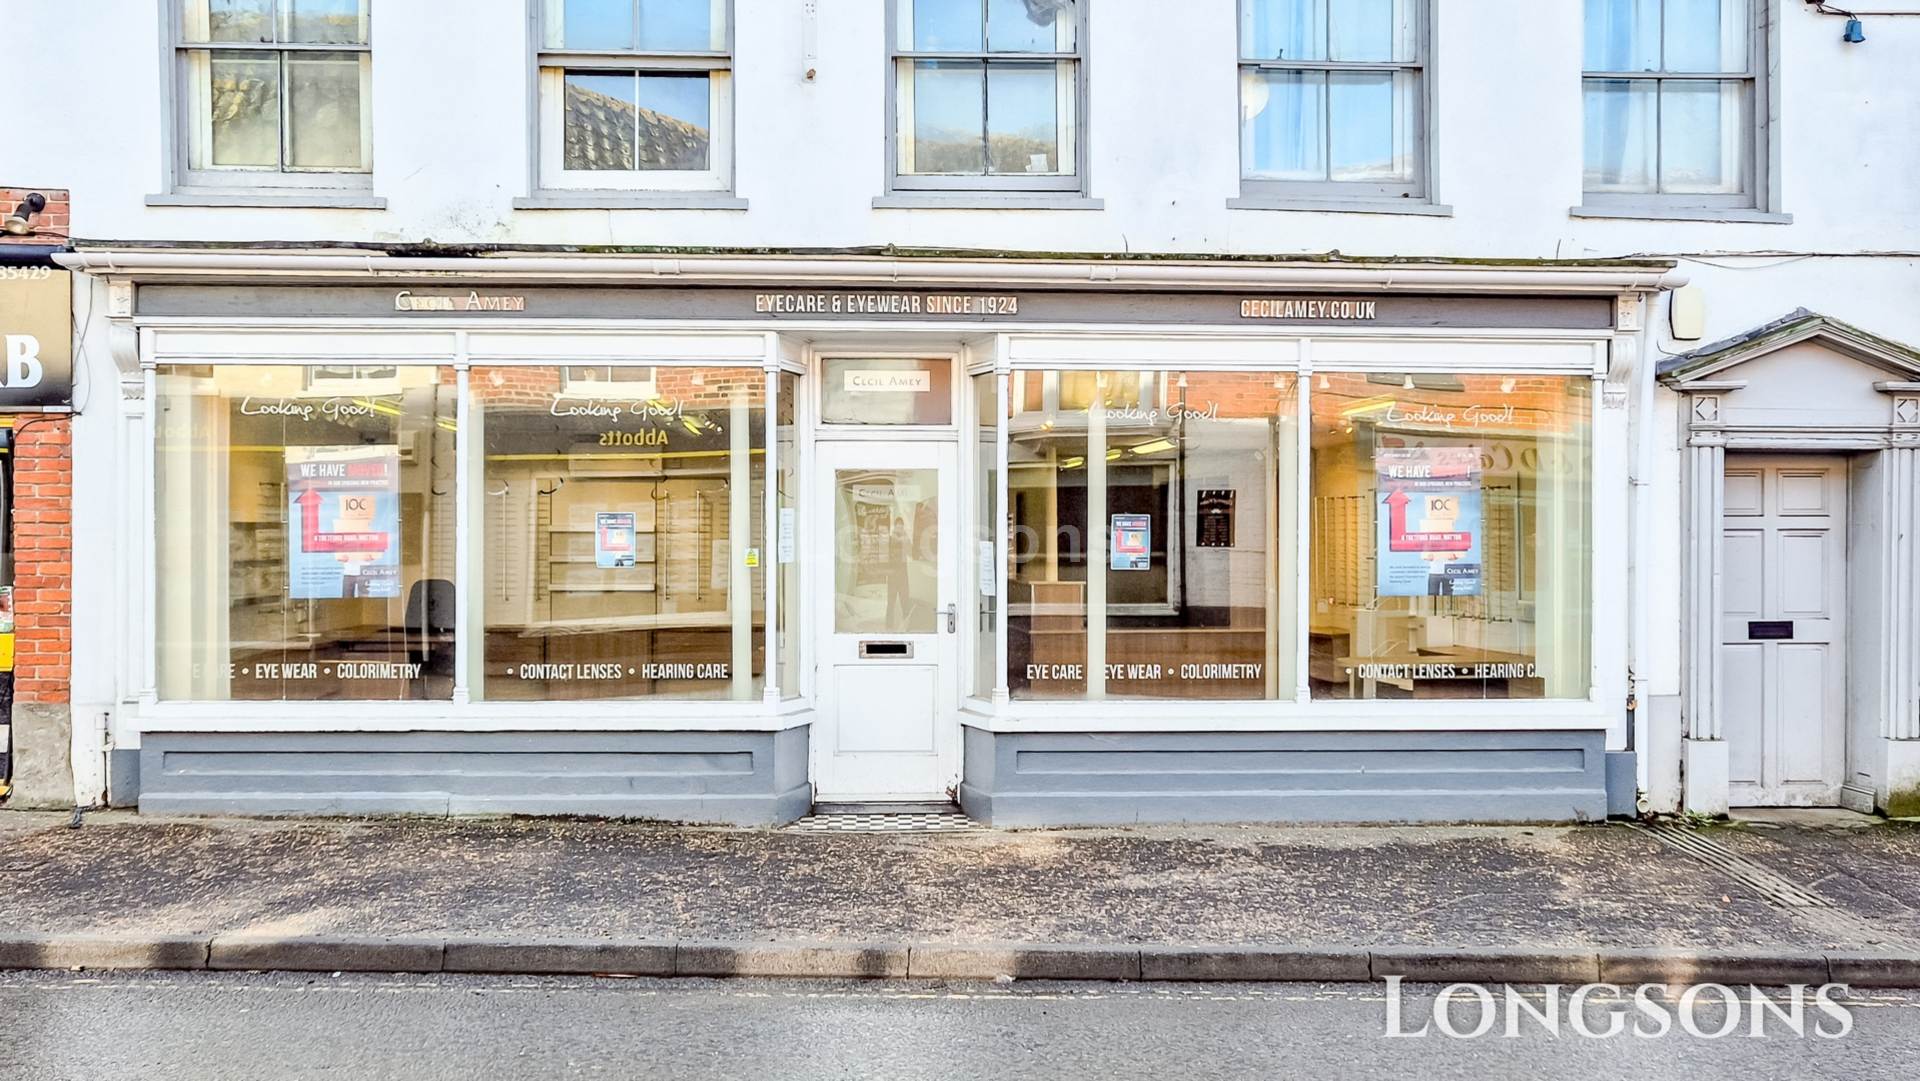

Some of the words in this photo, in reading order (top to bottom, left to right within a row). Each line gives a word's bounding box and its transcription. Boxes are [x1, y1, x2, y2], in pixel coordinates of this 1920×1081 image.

[395, 291, 454, 311] CECIL
[466, 291, 525, 311] AMEY
[755, 294, 826, 313] EYECARE
[831, 295, 841, 313] &
[847, 295, 921, 314] EYEWEAR
[926, 296, 971, 314] SINCE
[980, 296, 1019, 315] 1924
[1240, 300, 1377, 320] CECILAMEY.CO.UK
[852, 376, 883, 386] CECIL
[889, 376, 921, 386] AMEY
[240, 396, 314, 421] Looking
[322, 396, 376, 420] Good!
[550, 397, 622, 422] Looking
[630, 397, 685, 421] Good!
[1166, 400, 1219, 425] Good!
[1386, 402, 1456, 428] Looking
[1463, 403, 1515, 427] Good!
[301, 463, 317, 477] WE
[319, 463, 346, 477] HAVE
[1388, 465, 1405, 478] WE
[1406, 465, 1432, 478] HAVE
[255, 664, 279, 680] EYE
[282, 664, 317, 680] WEAR
[337, 664, 421, 680] COLORIMETRY
[520, 664, 574, 680] CONTACT
[576, 664, 622, 680] LENSES
[642, 664, 694, 680] HEARING
[697, 664, 729, 680] CARE
[1026, 664, 1049, 680] EYE
[1051, 664, 1083, 680] CARE
[1104, 664, 1124, 680] EYE
[1127, 664, 1162, 680] WEAR
[1180, 664, 1262, 680] COLORIMETRY
[1358, 664, 1411, 680] CONTACT
[1413, 664, 1456, 680] LENSES
[1474, 664, 1524, 680] HEARING
